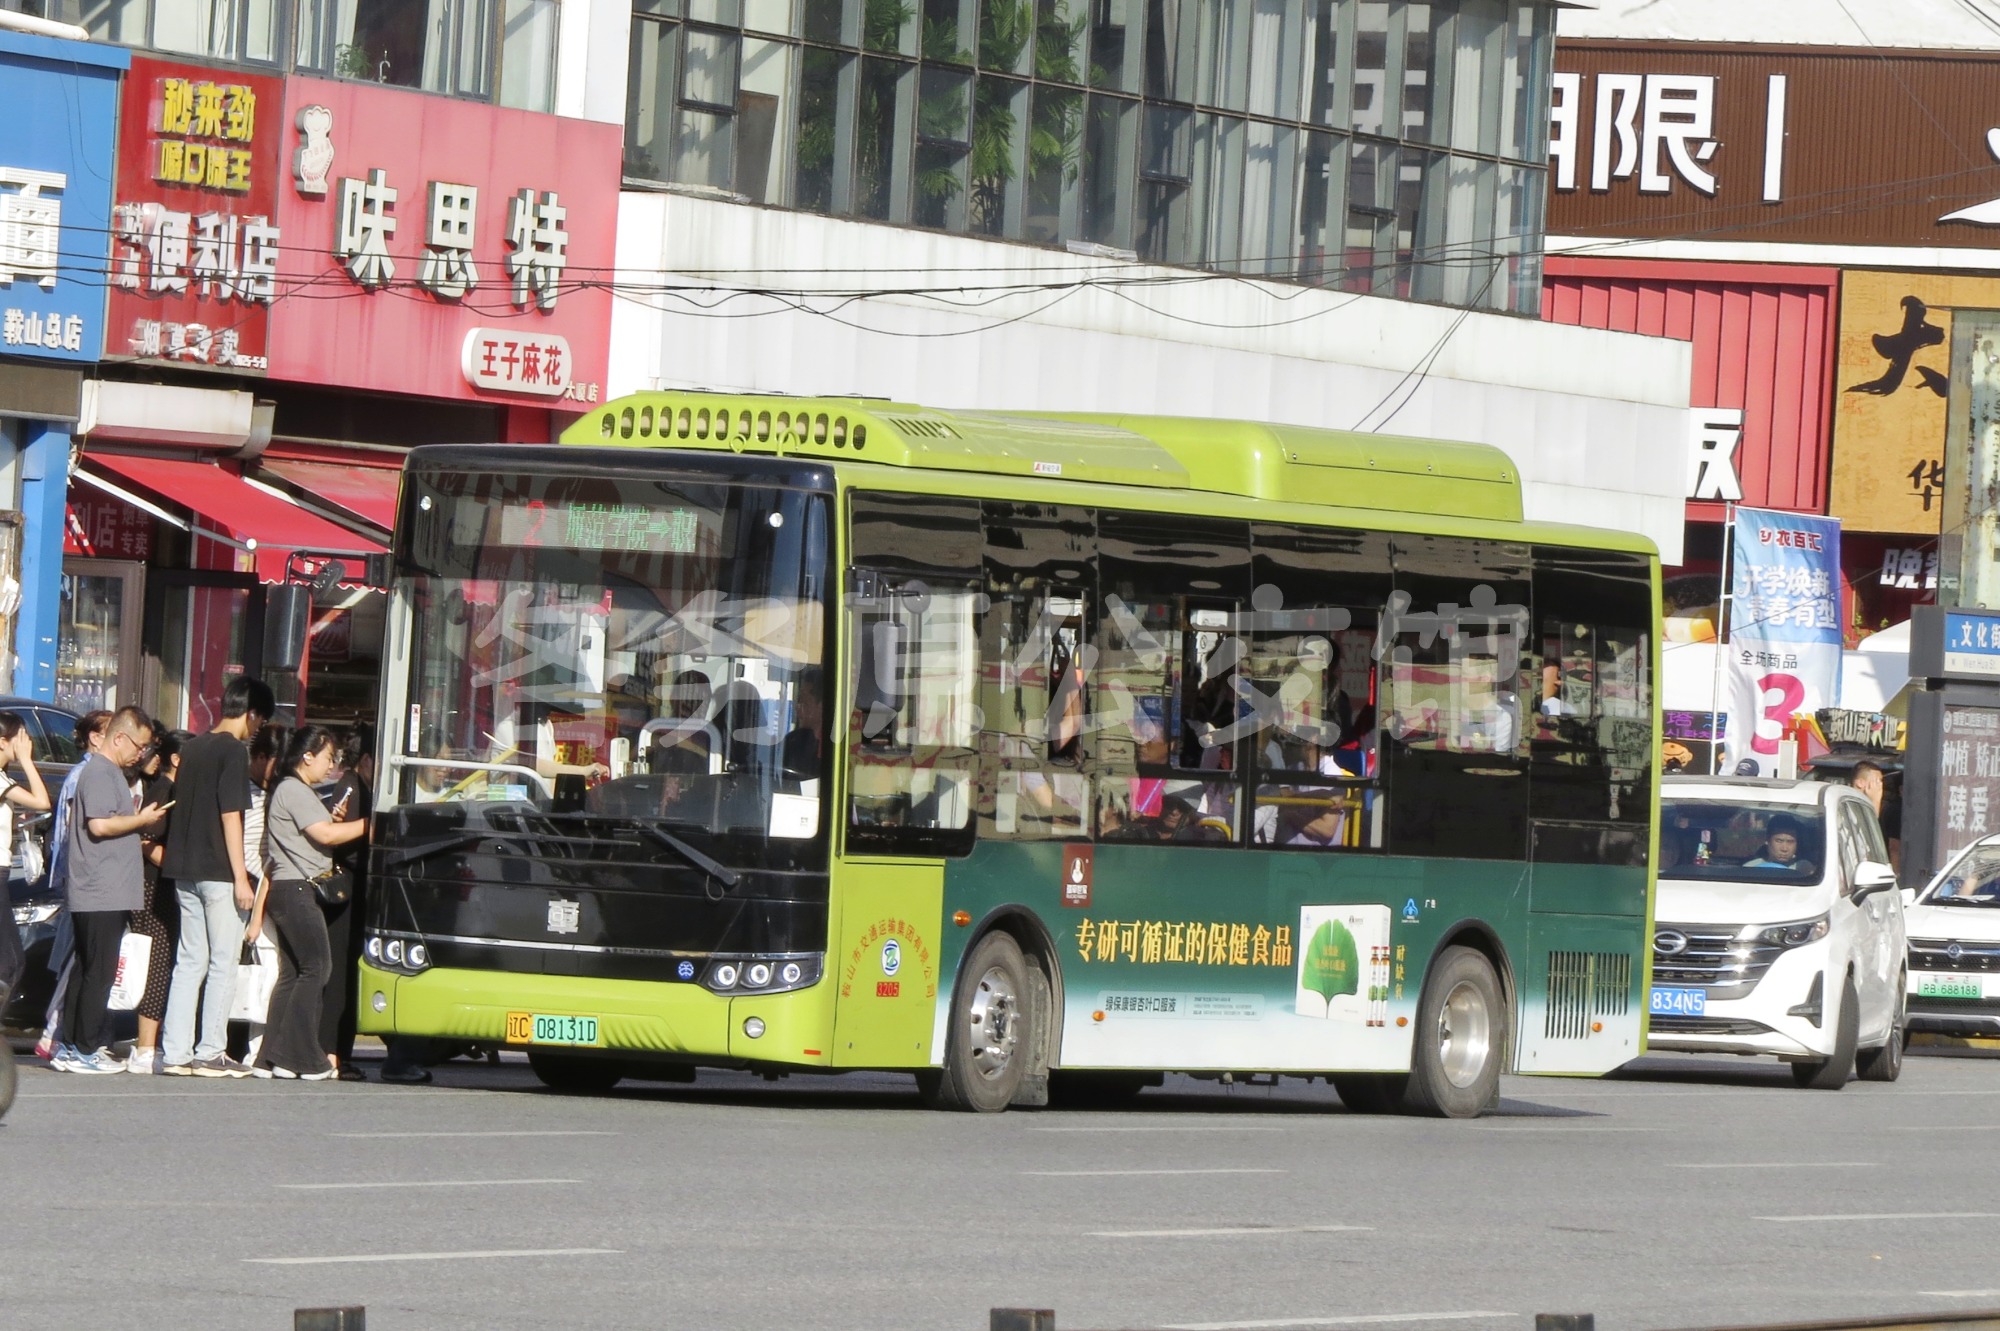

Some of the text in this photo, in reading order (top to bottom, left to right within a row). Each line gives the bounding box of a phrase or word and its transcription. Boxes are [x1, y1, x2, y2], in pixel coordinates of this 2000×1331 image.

[333, 168, 569, 312] 味思特
[3, 308, 84, 352] 鞍山总店
[480, 340, 563, 386] 王子麻花
[523, 499, 546, 546] 2
[1737, 565, 1830, 598] 开学焕新
[1748, 597, 1838, 630] 青春有型
[1740, 650, 1798, 670] 全场商品
[1750, 673, 1806, 755] 3
[1942, 739, 1970, 777] 种植
[1075, 917, 1293, 967] 专研可循证的保健食品
[876, 982, 899, 997] 3205
[1652, 992, 1703, 1013] 834N5
[509, 1016, 592, 1042] 辽C 08131D
